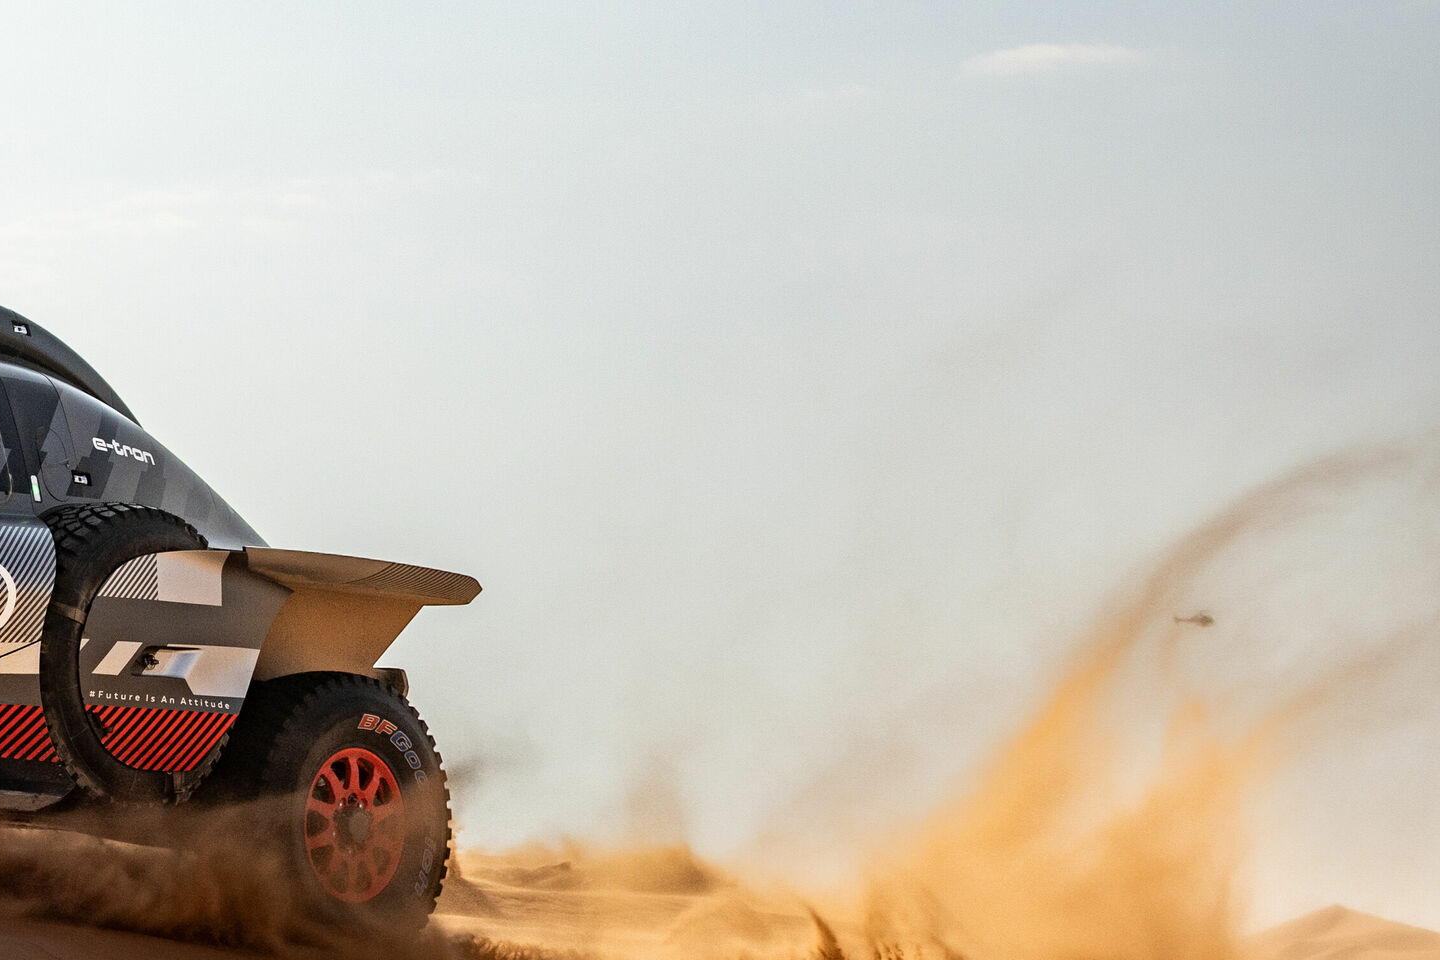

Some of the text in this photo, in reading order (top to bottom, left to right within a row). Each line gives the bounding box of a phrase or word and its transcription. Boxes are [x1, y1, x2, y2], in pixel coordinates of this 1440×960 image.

[92, 437, 156, 466] e-tron
[89, 690, 231, 710] #Future Is An Attitude
